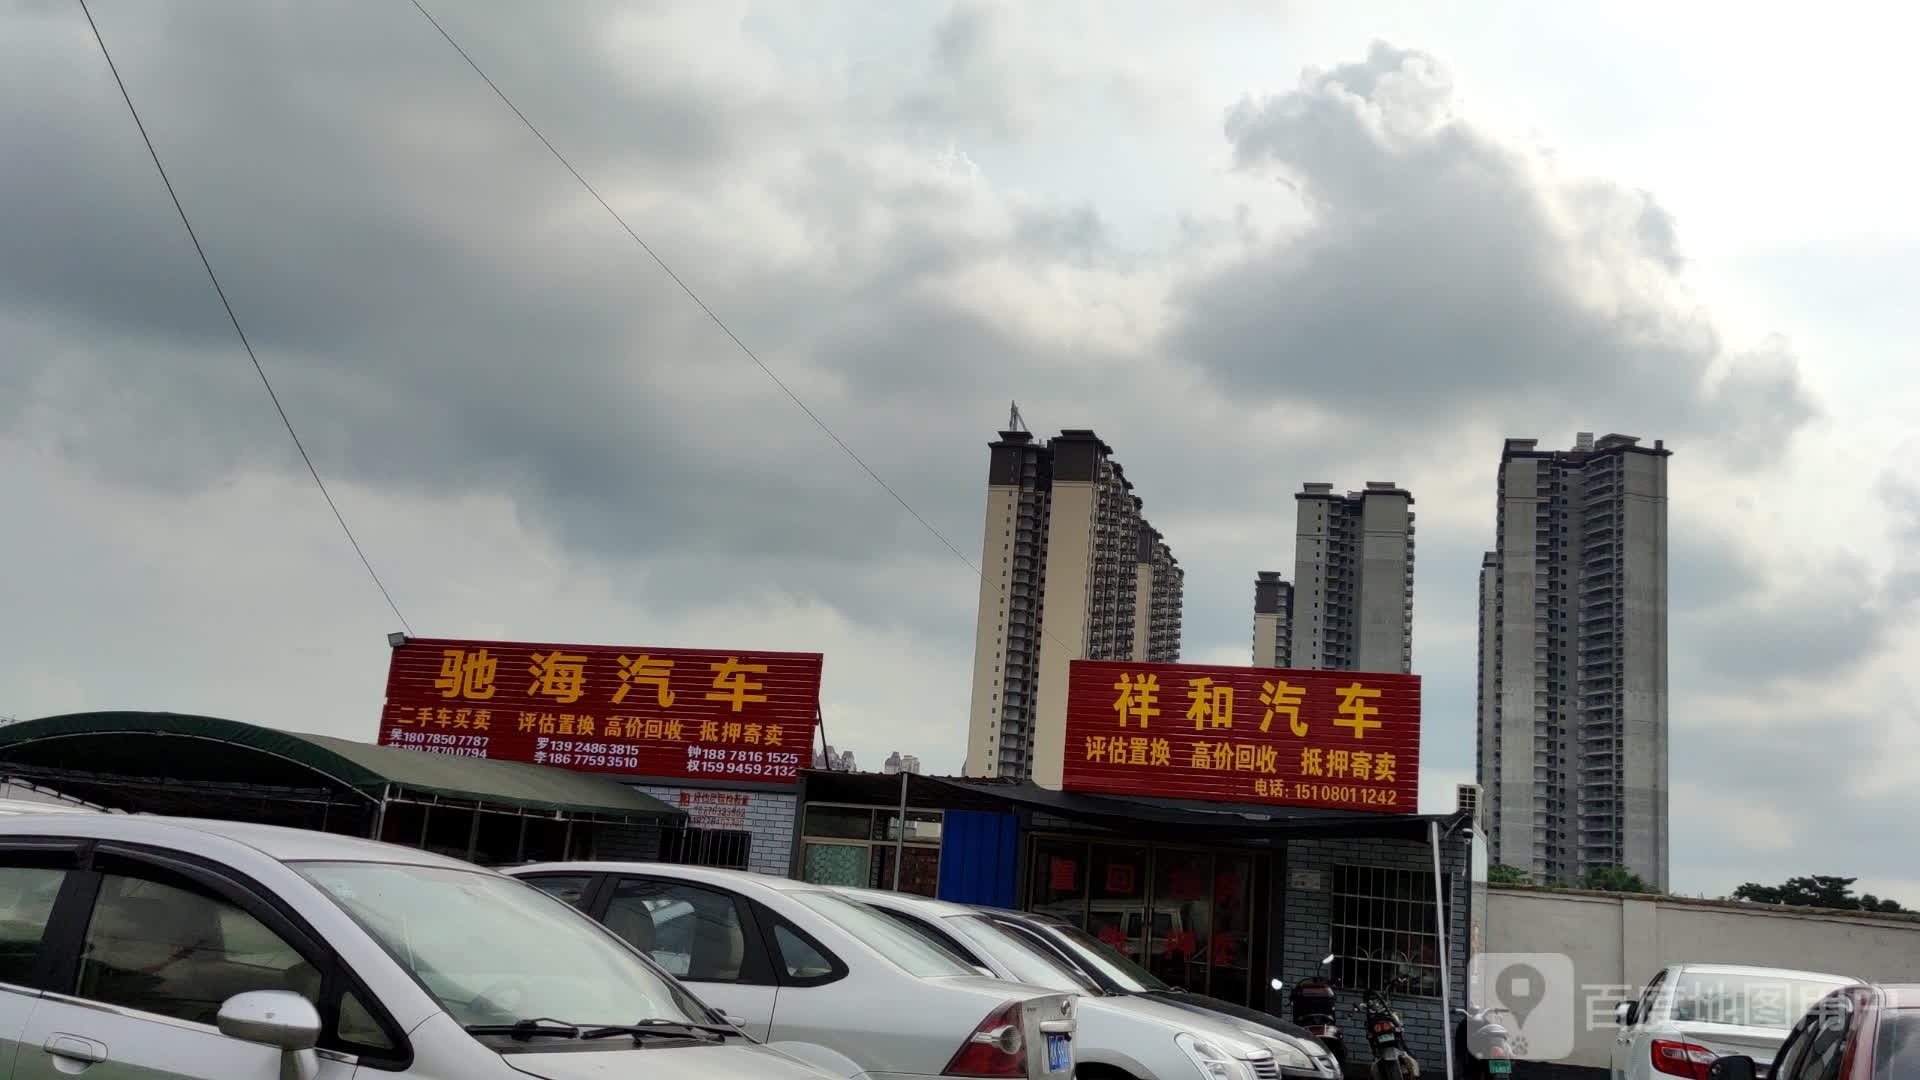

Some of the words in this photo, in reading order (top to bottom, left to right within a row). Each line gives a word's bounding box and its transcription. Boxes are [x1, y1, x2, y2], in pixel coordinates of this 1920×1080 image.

[435, 649, 768, 713] 驰海汽车
[1113, 672, 1383, 740] 祥和汽车
[397, 706, 492, 730] 二手车买卖
[517, 711, 595, 736] 评估置换
[604, 716, 683, 740] 高价回收
[699, 720, 784, 746] 抵押寄卖
[1085, 735, 1171, 766] 评估置换
[1191, 741, 1278, 774] 高价回收
[1300, 747, 1396, 783] 抵押寄卖
